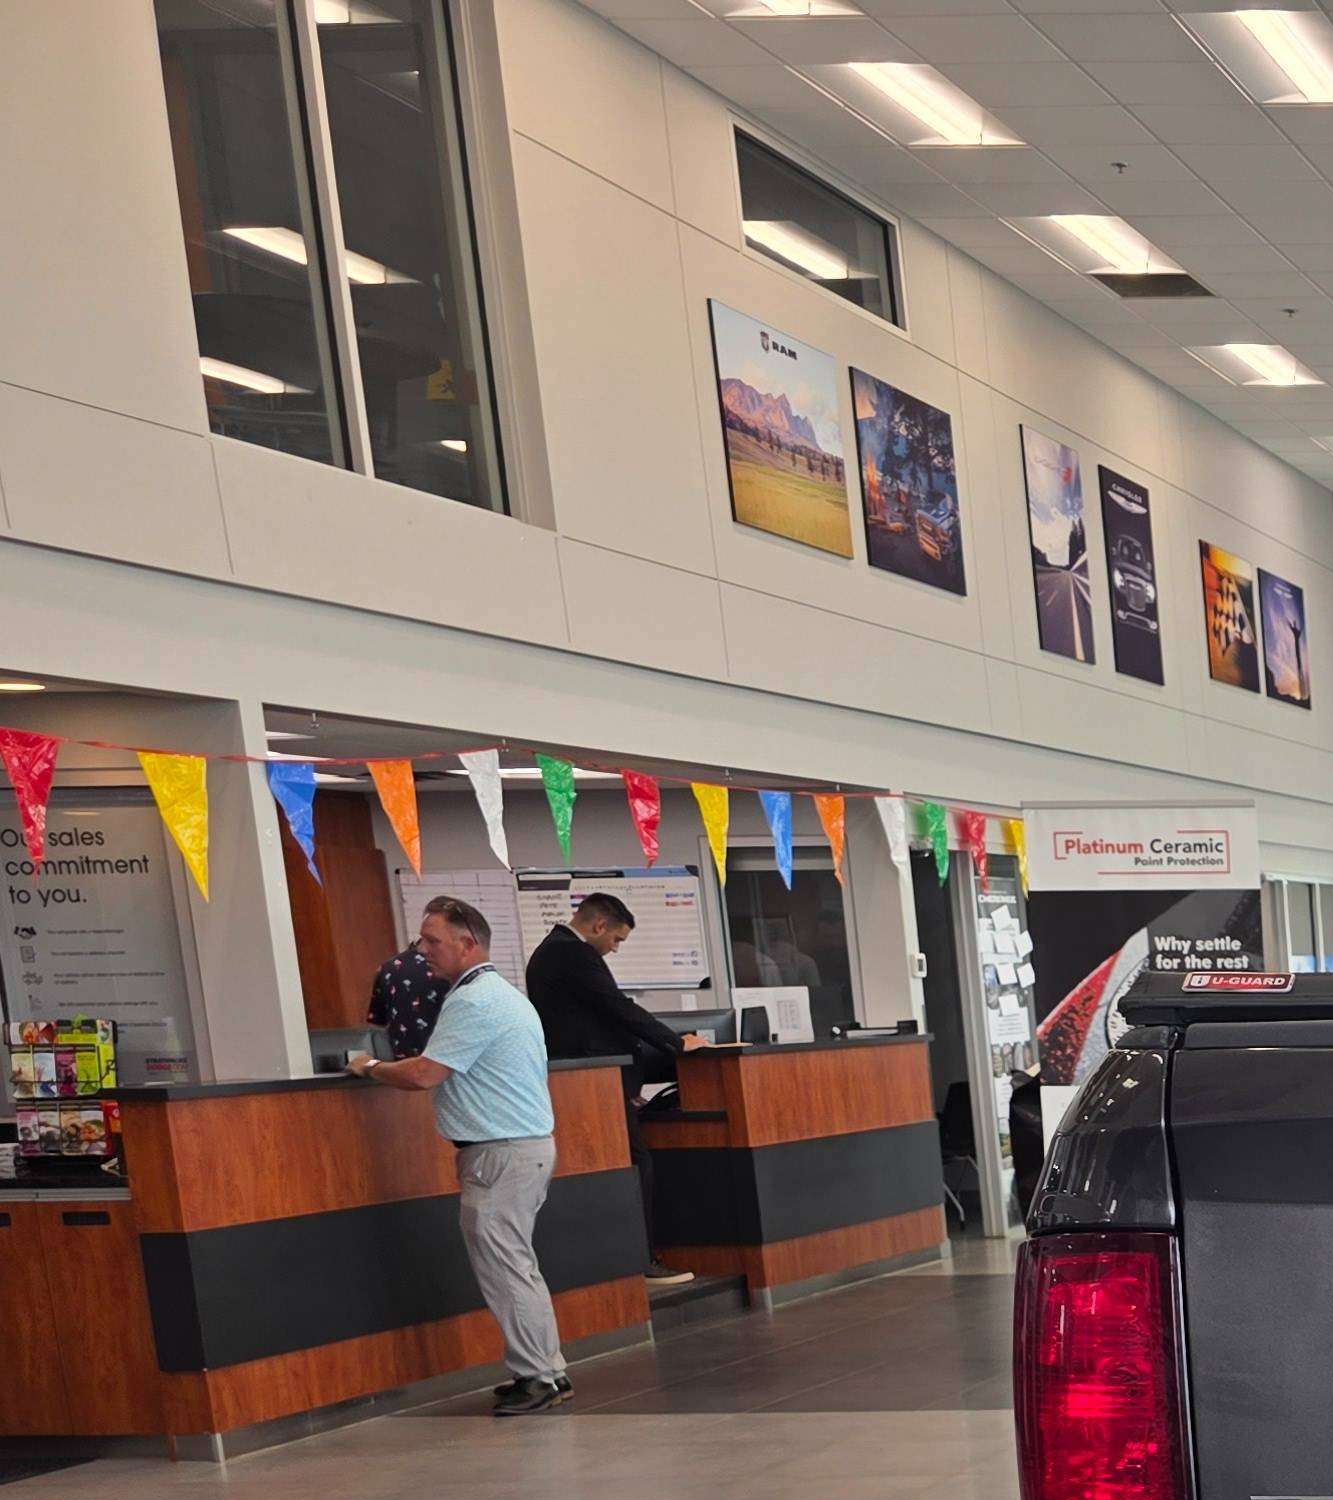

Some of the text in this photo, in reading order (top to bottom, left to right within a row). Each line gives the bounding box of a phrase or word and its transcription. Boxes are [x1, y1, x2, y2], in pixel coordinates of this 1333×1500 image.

[772, 341, 797, 360] RAM
[48, 828, 105, 847] sales
[1064, 838, 1224, 854] Platinum Ceramic
[5, 854, 150, 876] commitment
[1134, 856, 1224, 866] Paint Protection
[9, 885, 87, 908] to you.
[1154, 936, 1242, 954] Why settle
[1155, 954, 1249, 969] for the rest
[1212, 976, 1286, 986] U-GUARD
